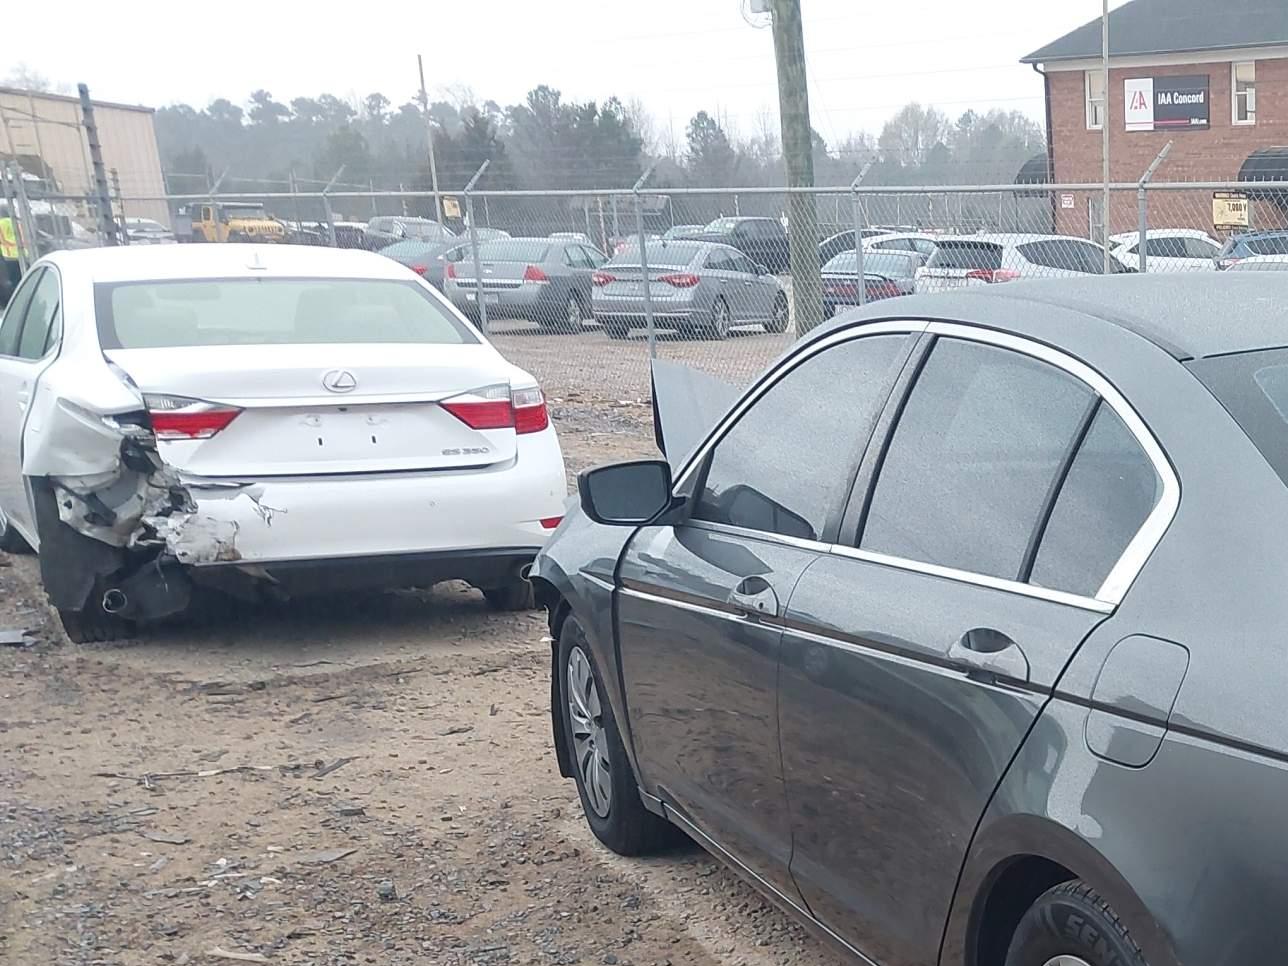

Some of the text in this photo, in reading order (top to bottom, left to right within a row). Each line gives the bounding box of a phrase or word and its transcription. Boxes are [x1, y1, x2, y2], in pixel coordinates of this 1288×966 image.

[1157, 91, 1204, 105] IAA Concord
[462, 447, 490, 455] 350
